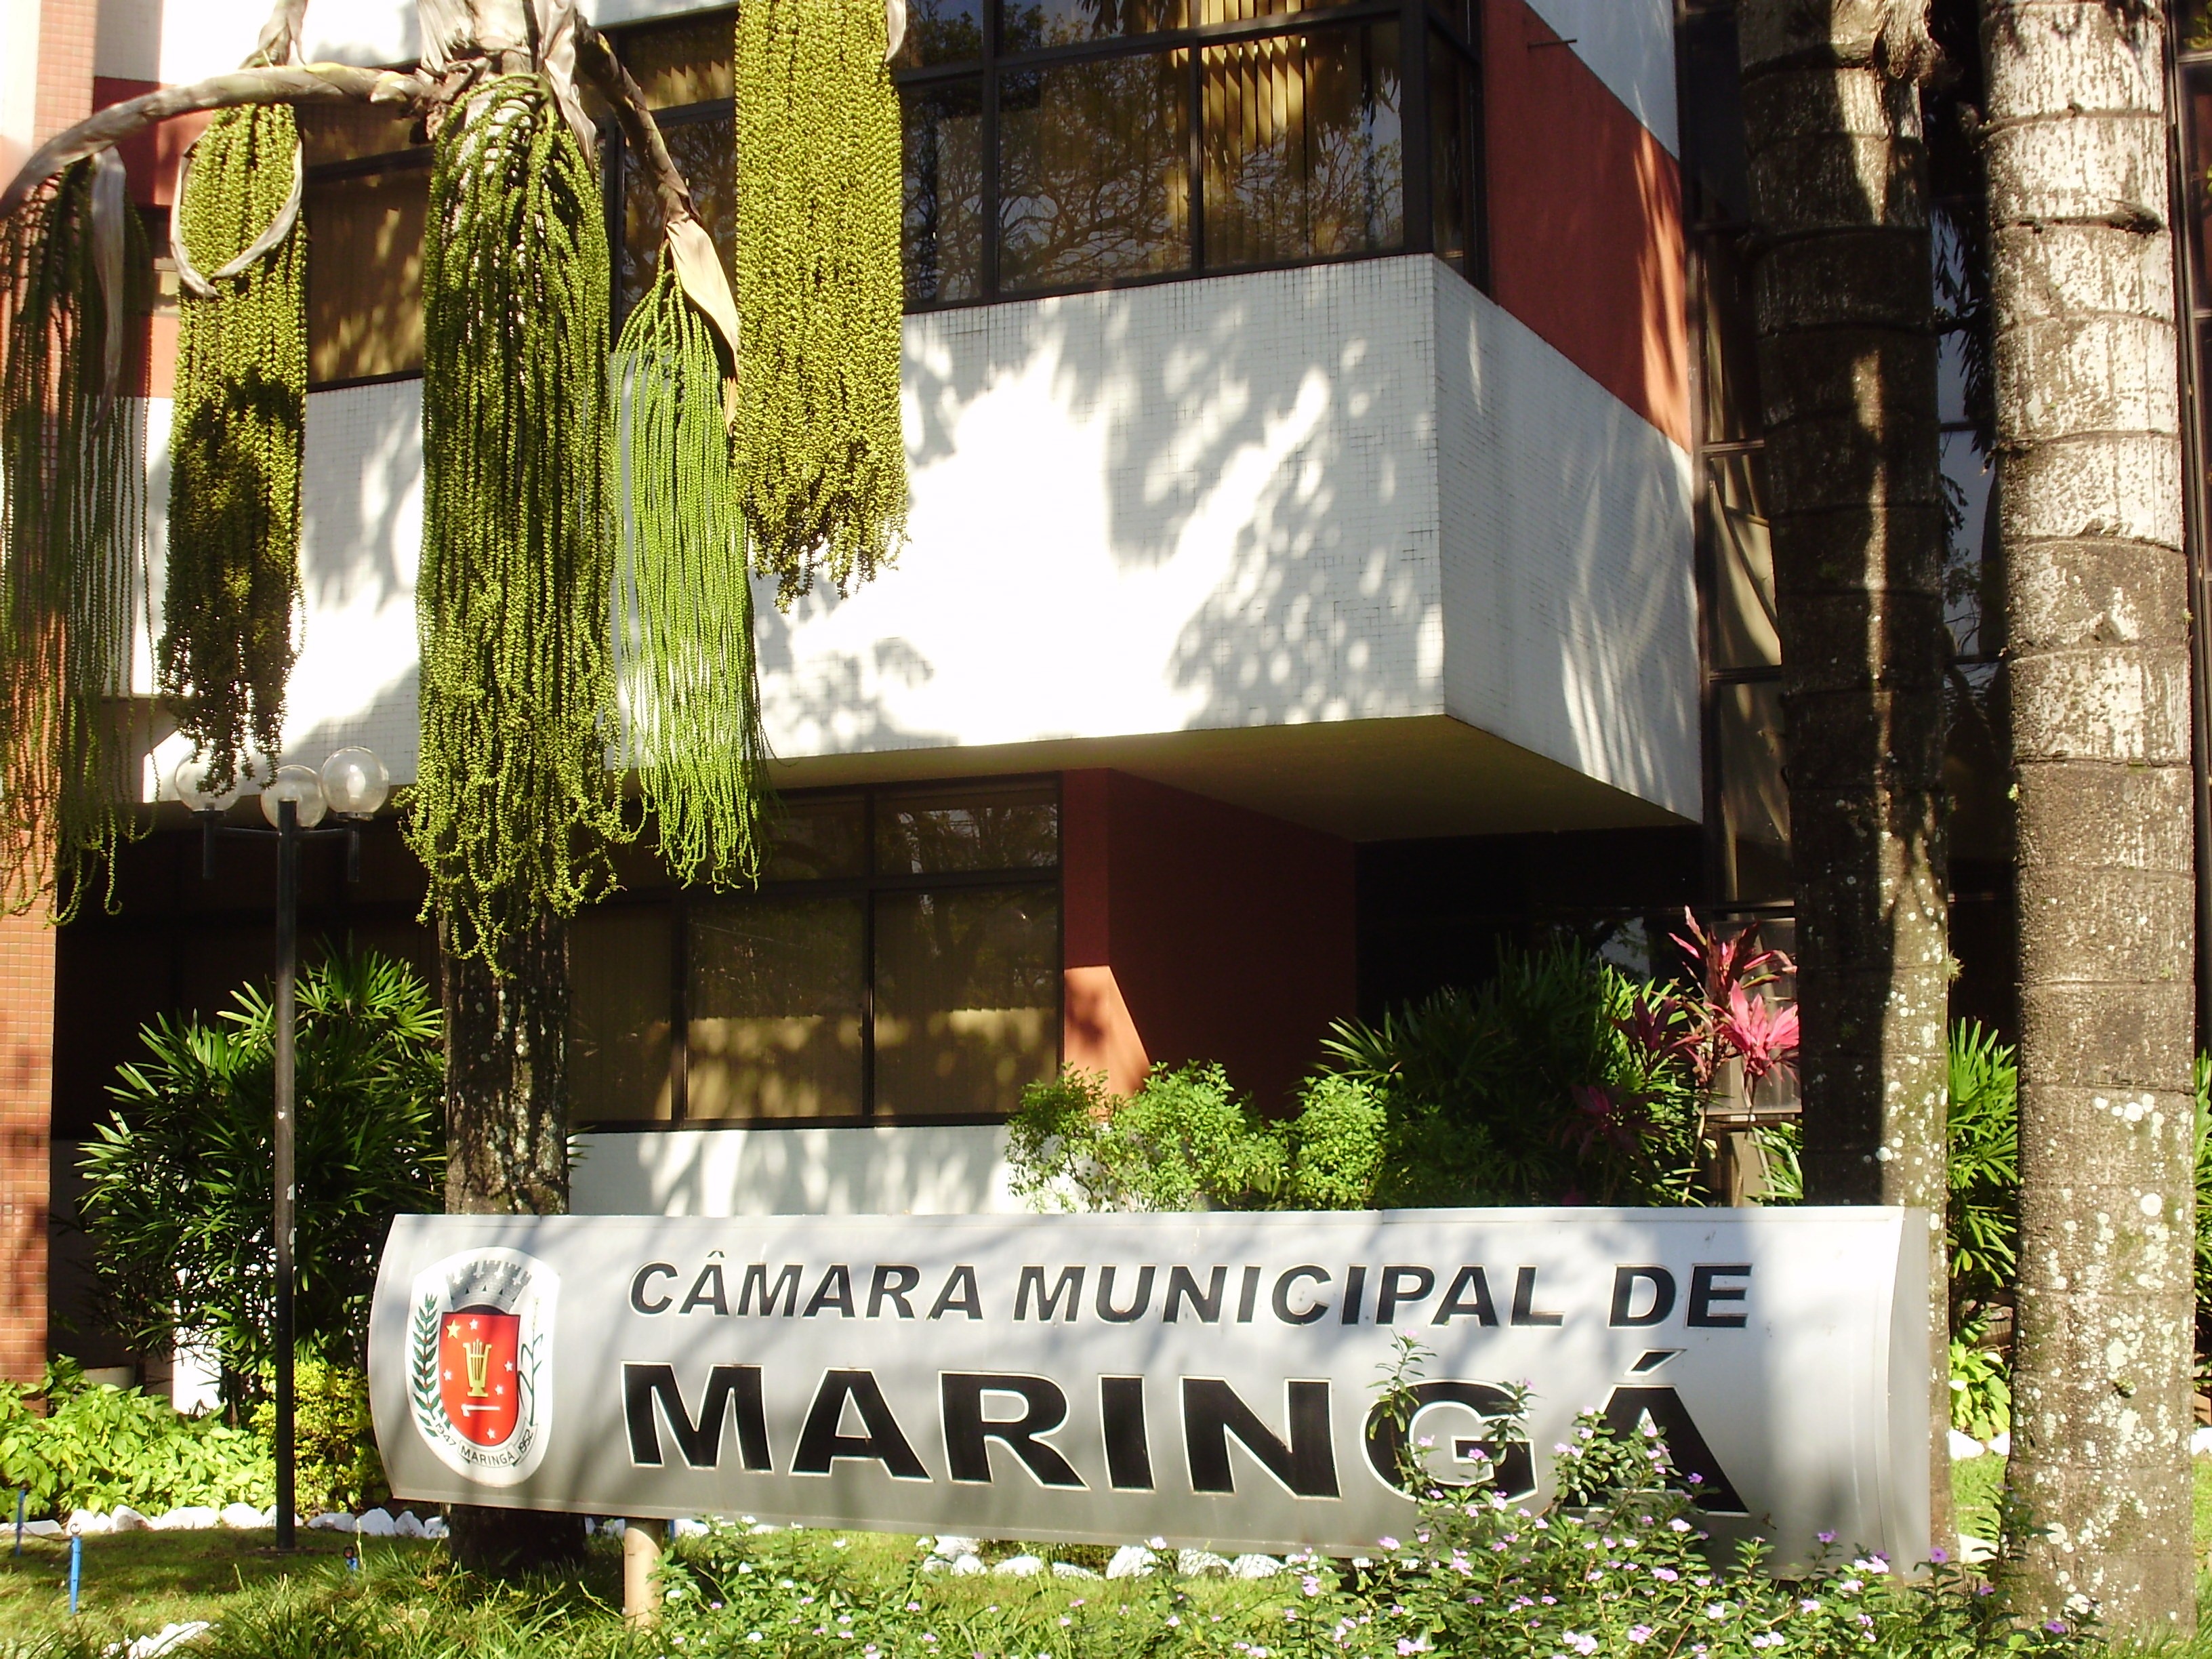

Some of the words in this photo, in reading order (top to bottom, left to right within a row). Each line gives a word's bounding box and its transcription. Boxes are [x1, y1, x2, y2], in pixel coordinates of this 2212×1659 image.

[628, 1250, 984, 1322] CÂMARA
[1012, 1264, 1565, 1328] MUNICIPAL
[1607, 1263, 1754, 1329] DE
[435, 1422, 457, 1446] 1947
[518, 1429, 533, 1454] 1952
[621, 1349, 1750, 1517] MARINGÁ
